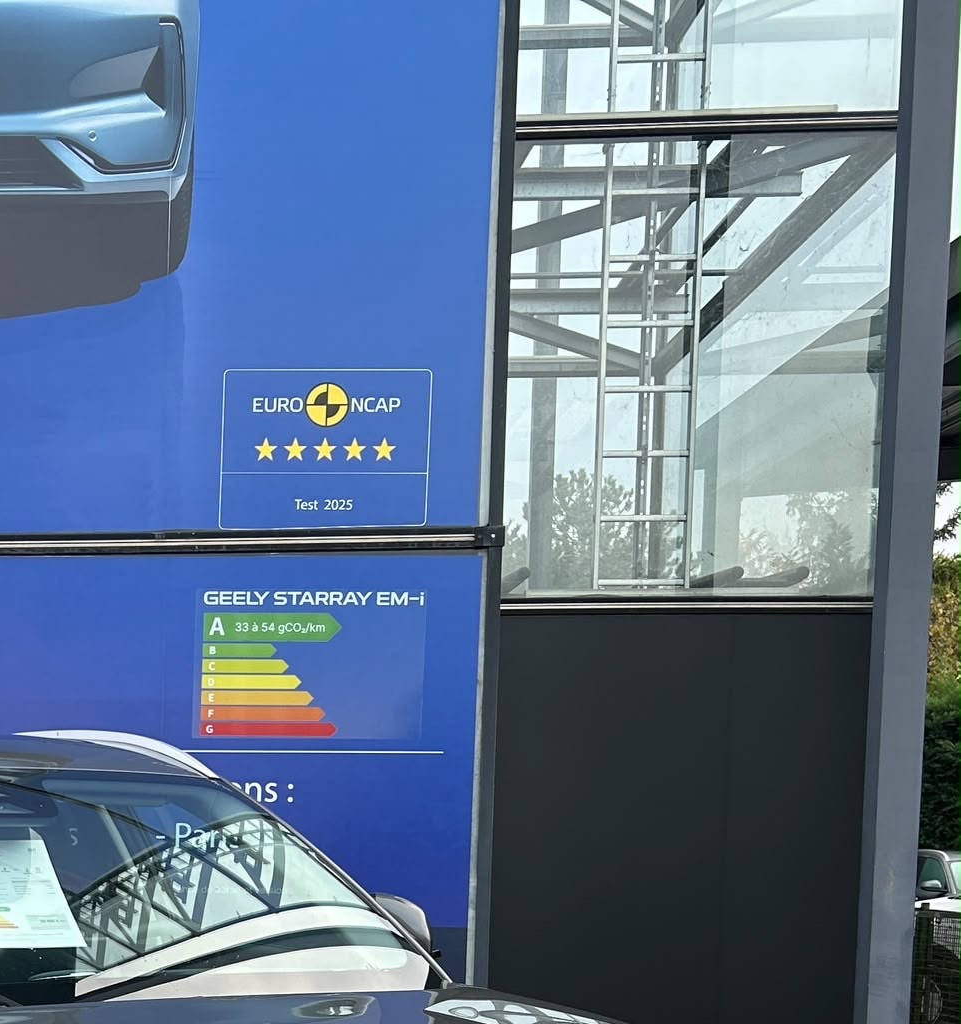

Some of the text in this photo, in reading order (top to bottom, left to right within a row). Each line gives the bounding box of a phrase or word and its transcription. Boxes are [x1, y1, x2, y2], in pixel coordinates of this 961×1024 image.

[252, 397, 401, 414] EURO NCAP
[294, 498, 354, 512] Test 2025
[203, 590, 426, 606] GEELY STARRAY EM-i
[208, 616, 225, 636] A
[234, 621, 249, 633] 33
[251, 621, 259, 633] à
[261, 621, 275, 633] 54
[208, 645, 217, 655] B
[207, 661, 216, 671] C
[206, 677, 216, 688] D
[207, 692, 215, 703] E
[206, 708, 215, 719] F
[205, 724, 214, 735] G
